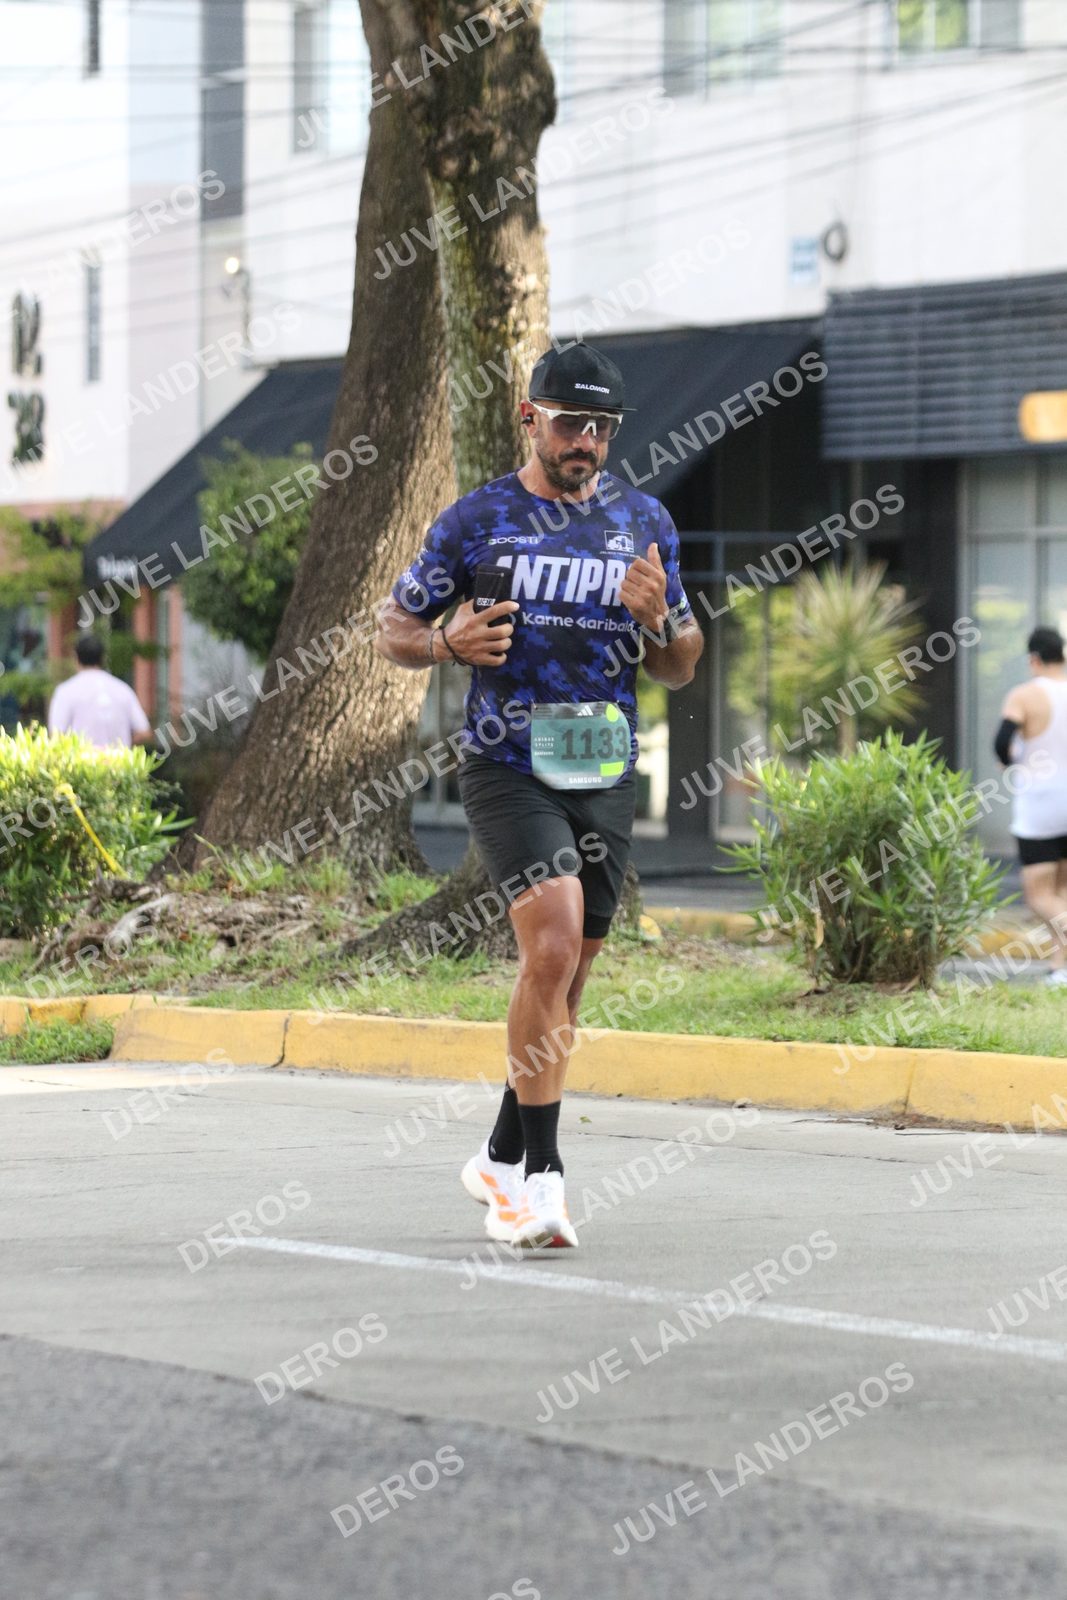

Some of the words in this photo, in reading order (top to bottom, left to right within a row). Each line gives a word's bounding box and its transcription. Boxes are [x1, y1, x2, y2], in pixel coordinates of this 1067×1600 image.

[574, 382, 610, 394] SALOMON
[496, 555, 632, 606] NTIPR
[522, 611, 573, 627] Karne
[561, 726, 628, 760] 1133
